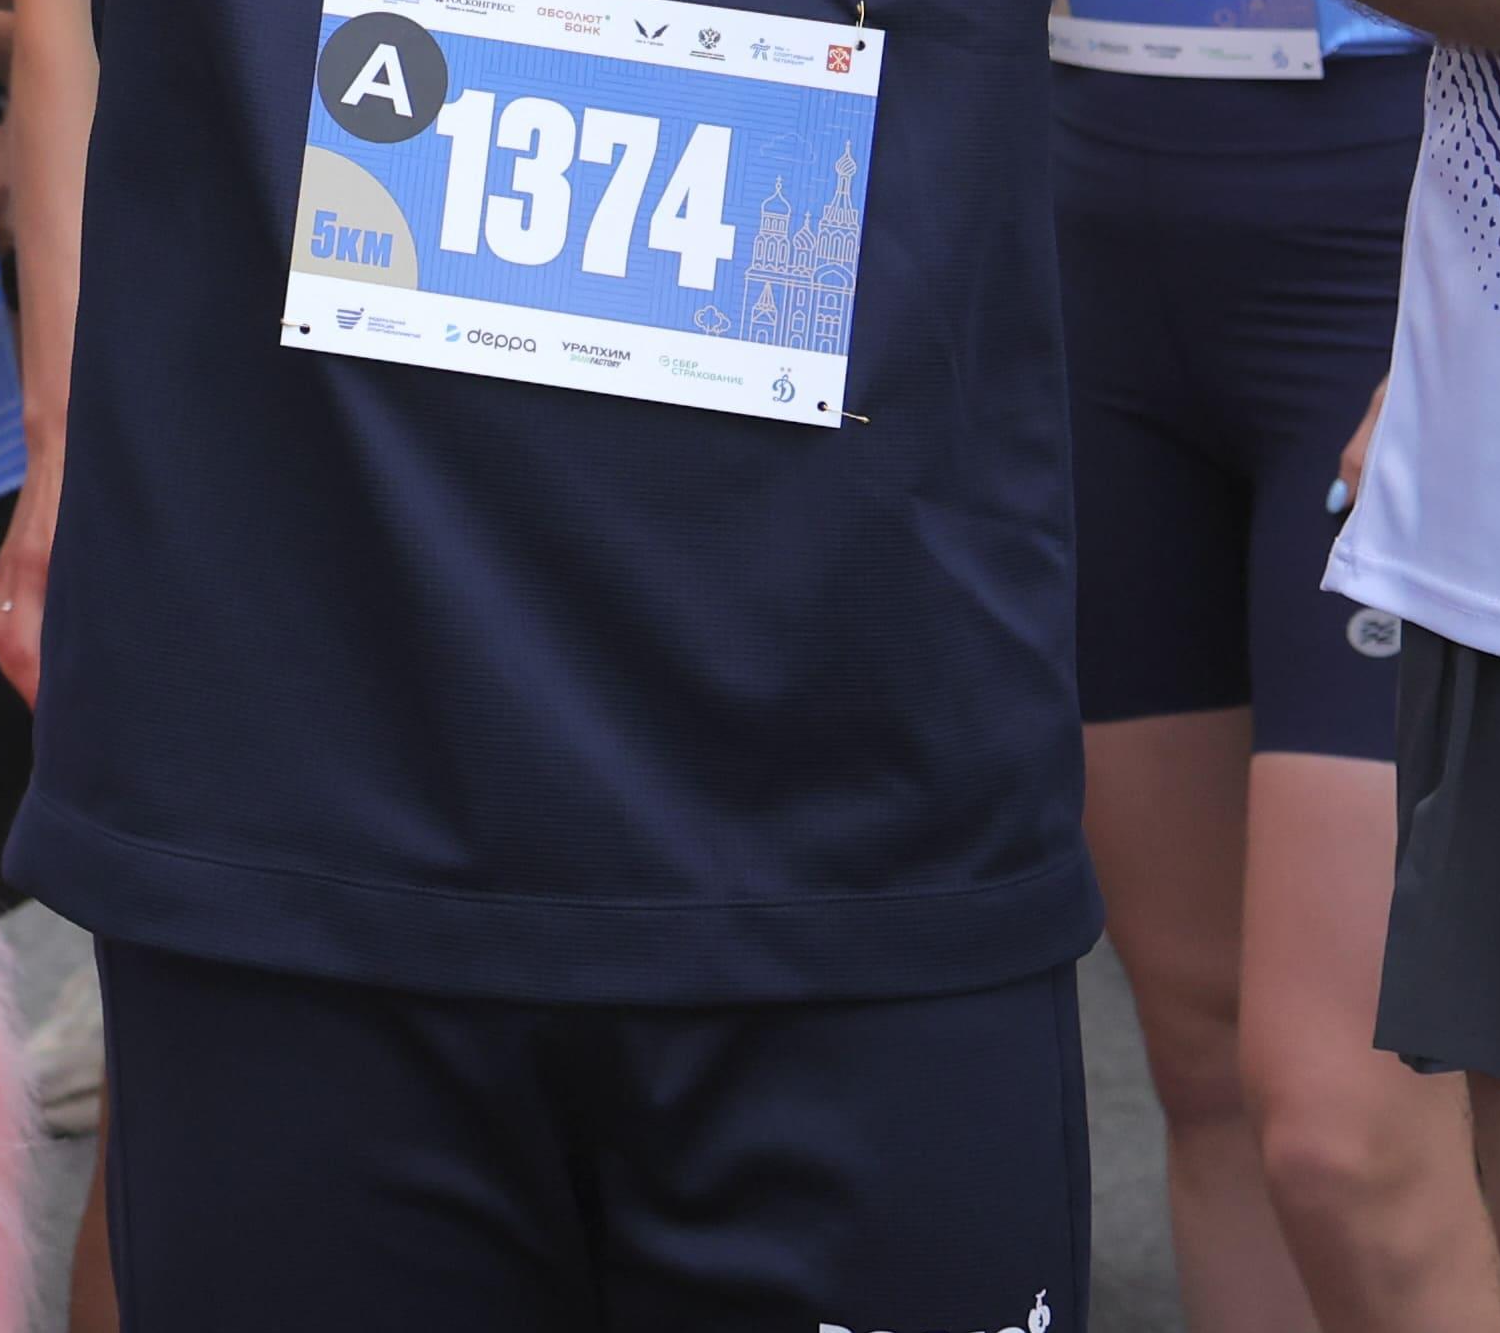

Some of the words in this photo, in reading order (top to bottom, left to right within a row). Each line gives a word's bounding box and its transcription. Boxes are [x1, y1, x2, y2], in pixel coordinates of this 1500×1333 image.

[436, 88, 736, 291] 1374
[467, 329, 537, 353] deppa
[561, 342, 631, 360] УРАЛХИМ
